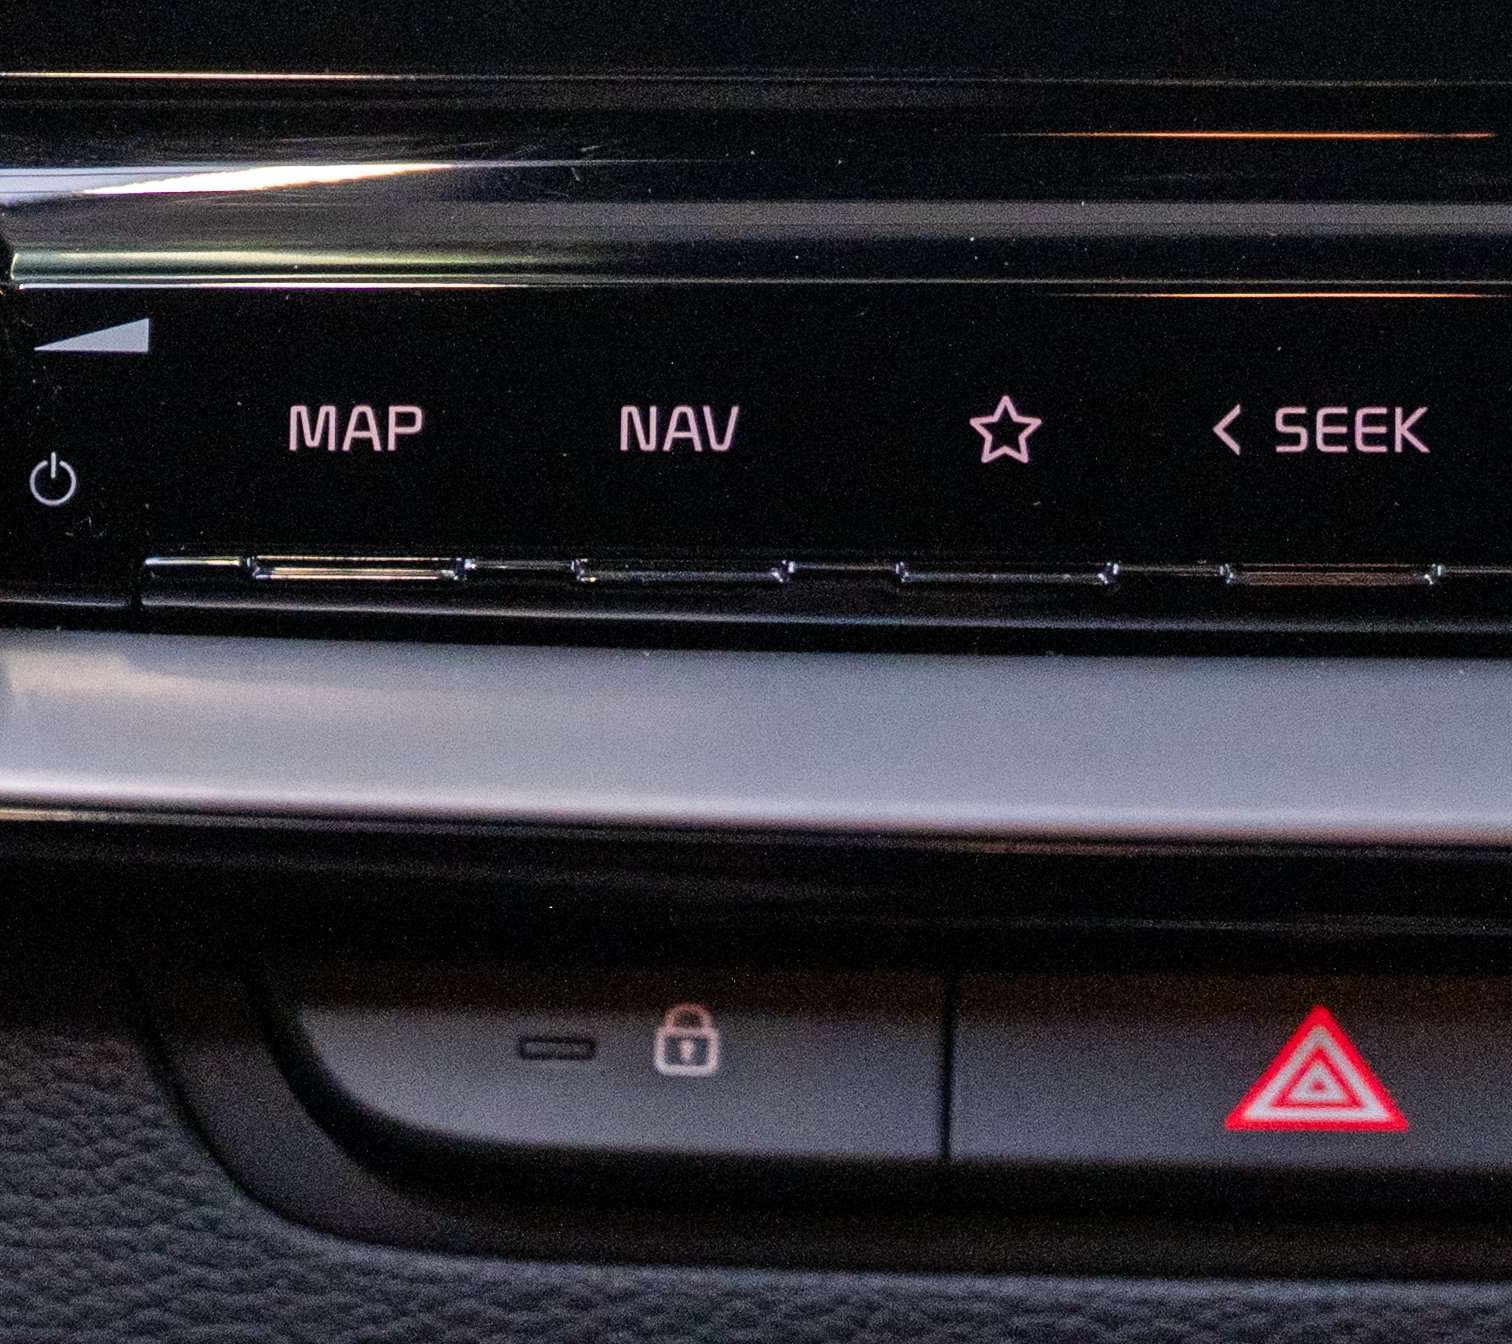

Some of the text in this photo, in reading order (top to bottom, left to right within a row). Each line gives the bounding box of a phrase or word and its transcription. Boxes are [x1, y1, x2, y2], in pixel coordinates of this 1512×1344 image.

[289, 405, 423, 452] MAP
[620, 405, 739, 452] NAV
[1275, 406, 1429, 453] SEEK
